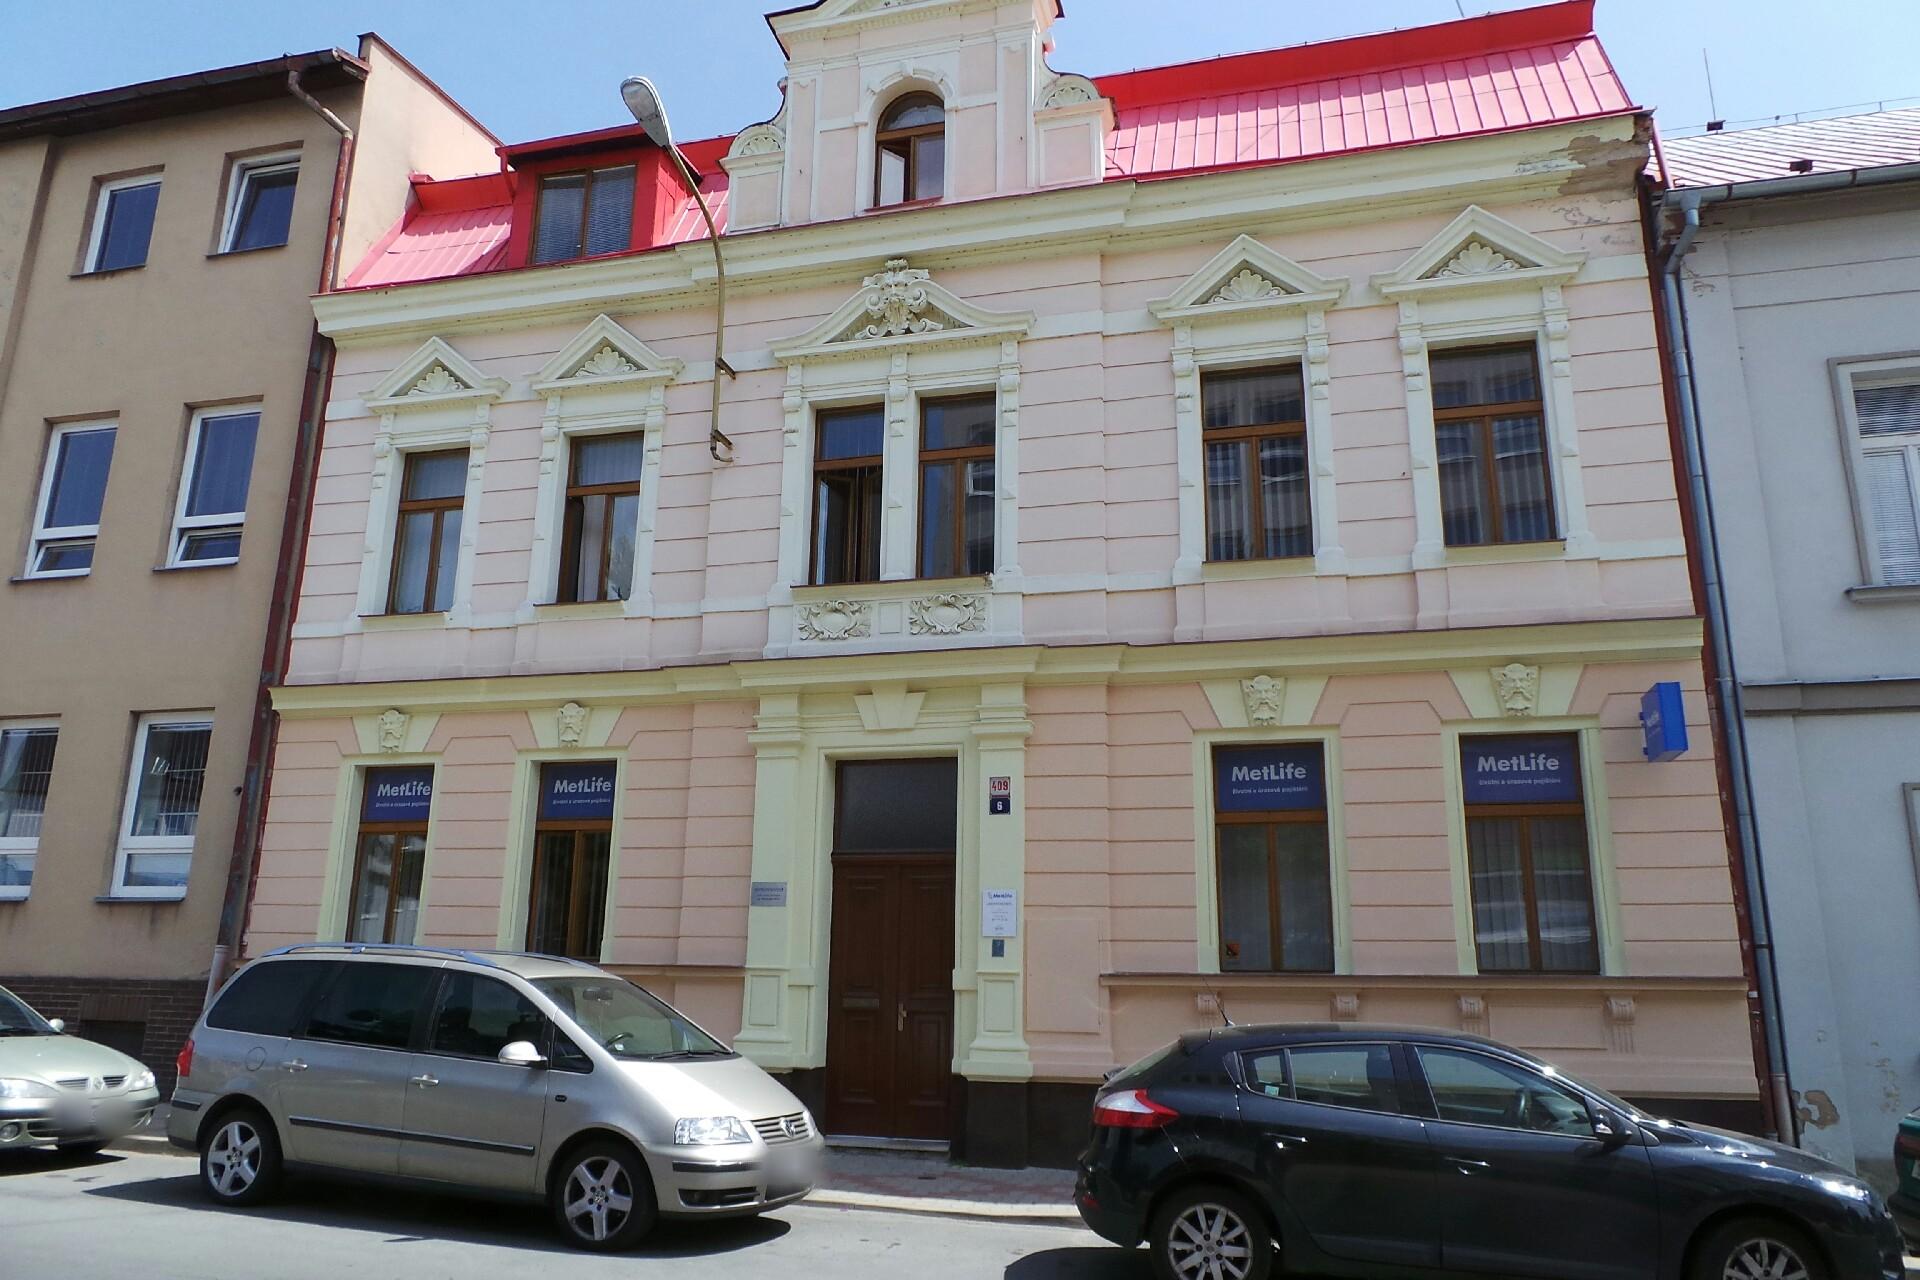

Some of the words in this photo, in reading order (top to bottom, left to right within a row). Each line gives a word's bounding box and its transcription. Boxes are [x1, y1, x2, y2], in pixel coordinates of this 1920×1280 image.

[1477, 752, 1560, 772] MetLife
[1231, 762, 1307, 782] MetLife
[377, 781, 431, 797] MetLife
[553, 777, 612, 793] MetLife
[991, 780, 1009, 791] 409
[996, 801, 1003, 811] 6
